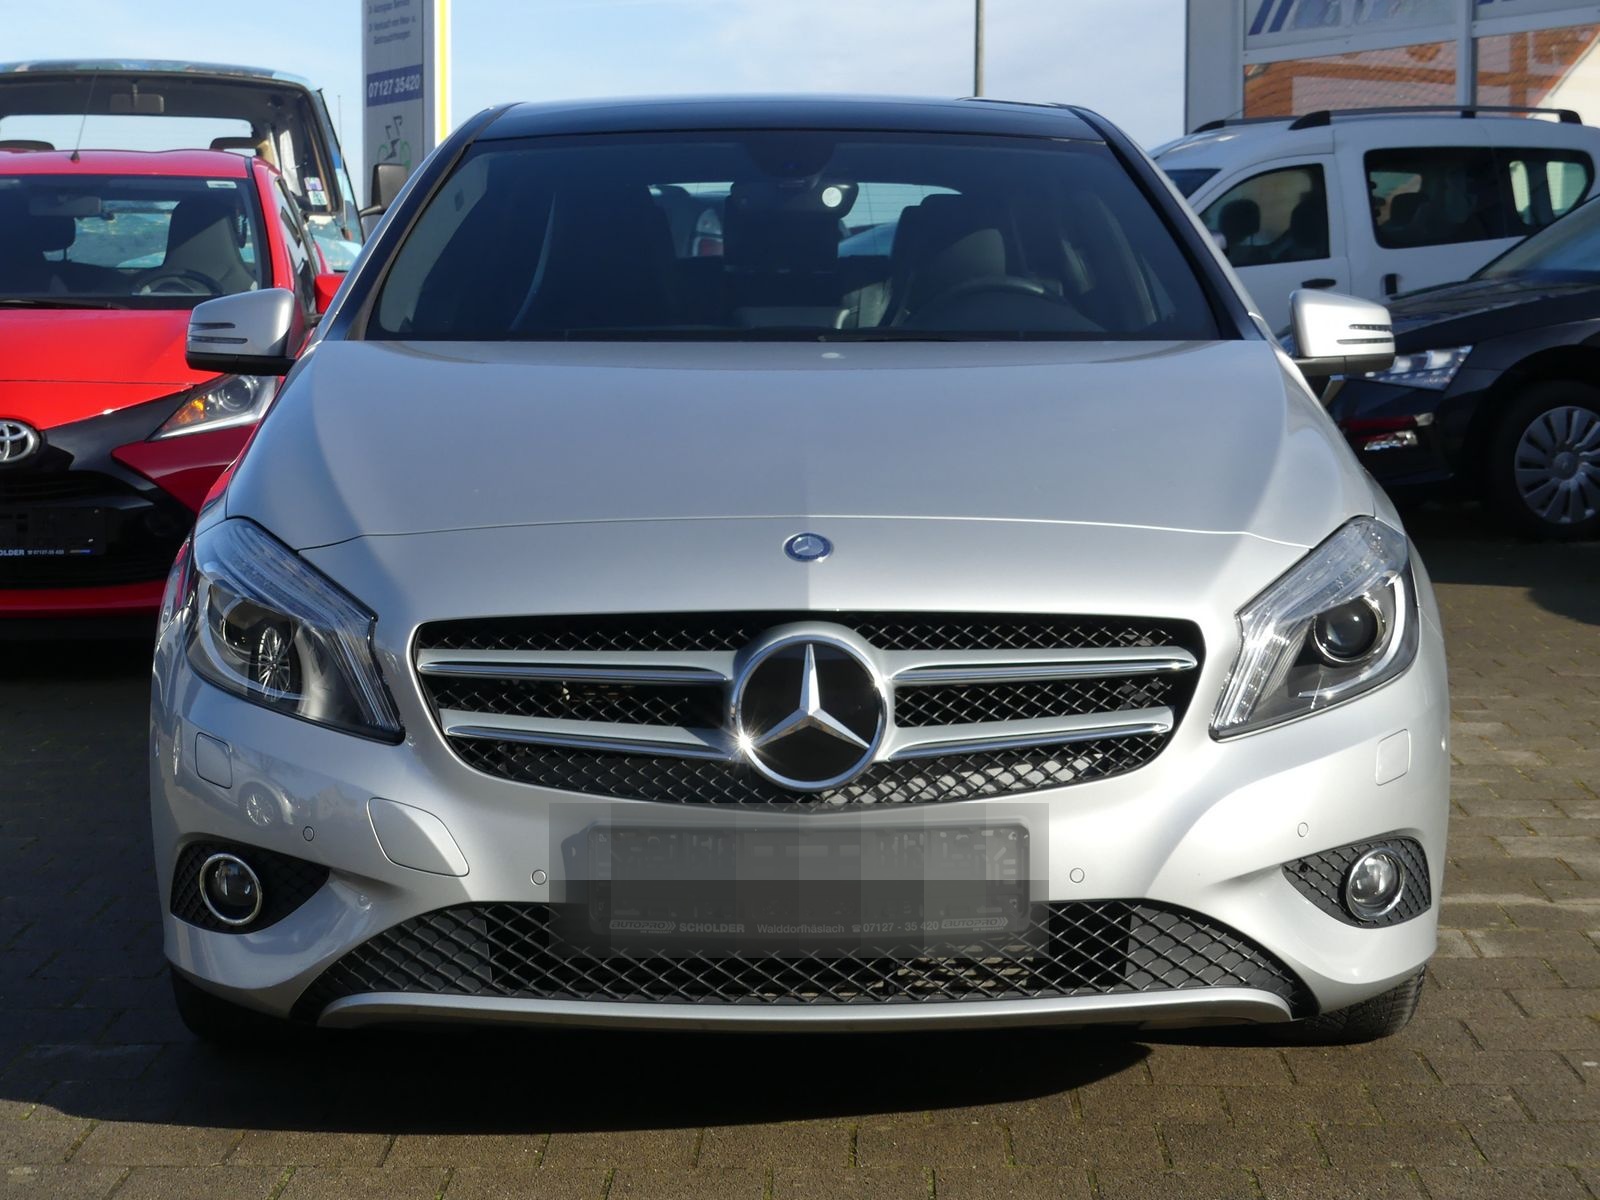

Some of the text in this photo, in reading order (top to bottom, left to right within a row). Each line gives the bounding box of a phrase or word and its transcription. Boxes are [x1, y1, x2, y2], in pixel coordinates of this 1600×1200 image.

[368, 73, 420, 98] 07127 35420
[679, 922, 745, 934] SCHOLDER
[757, 923, 845, 934] Walddorfhäslach
[863, 922, 894, 933] 07127
[904, 922, 917, 932] 35
[920, 921, 939, 931] 420
